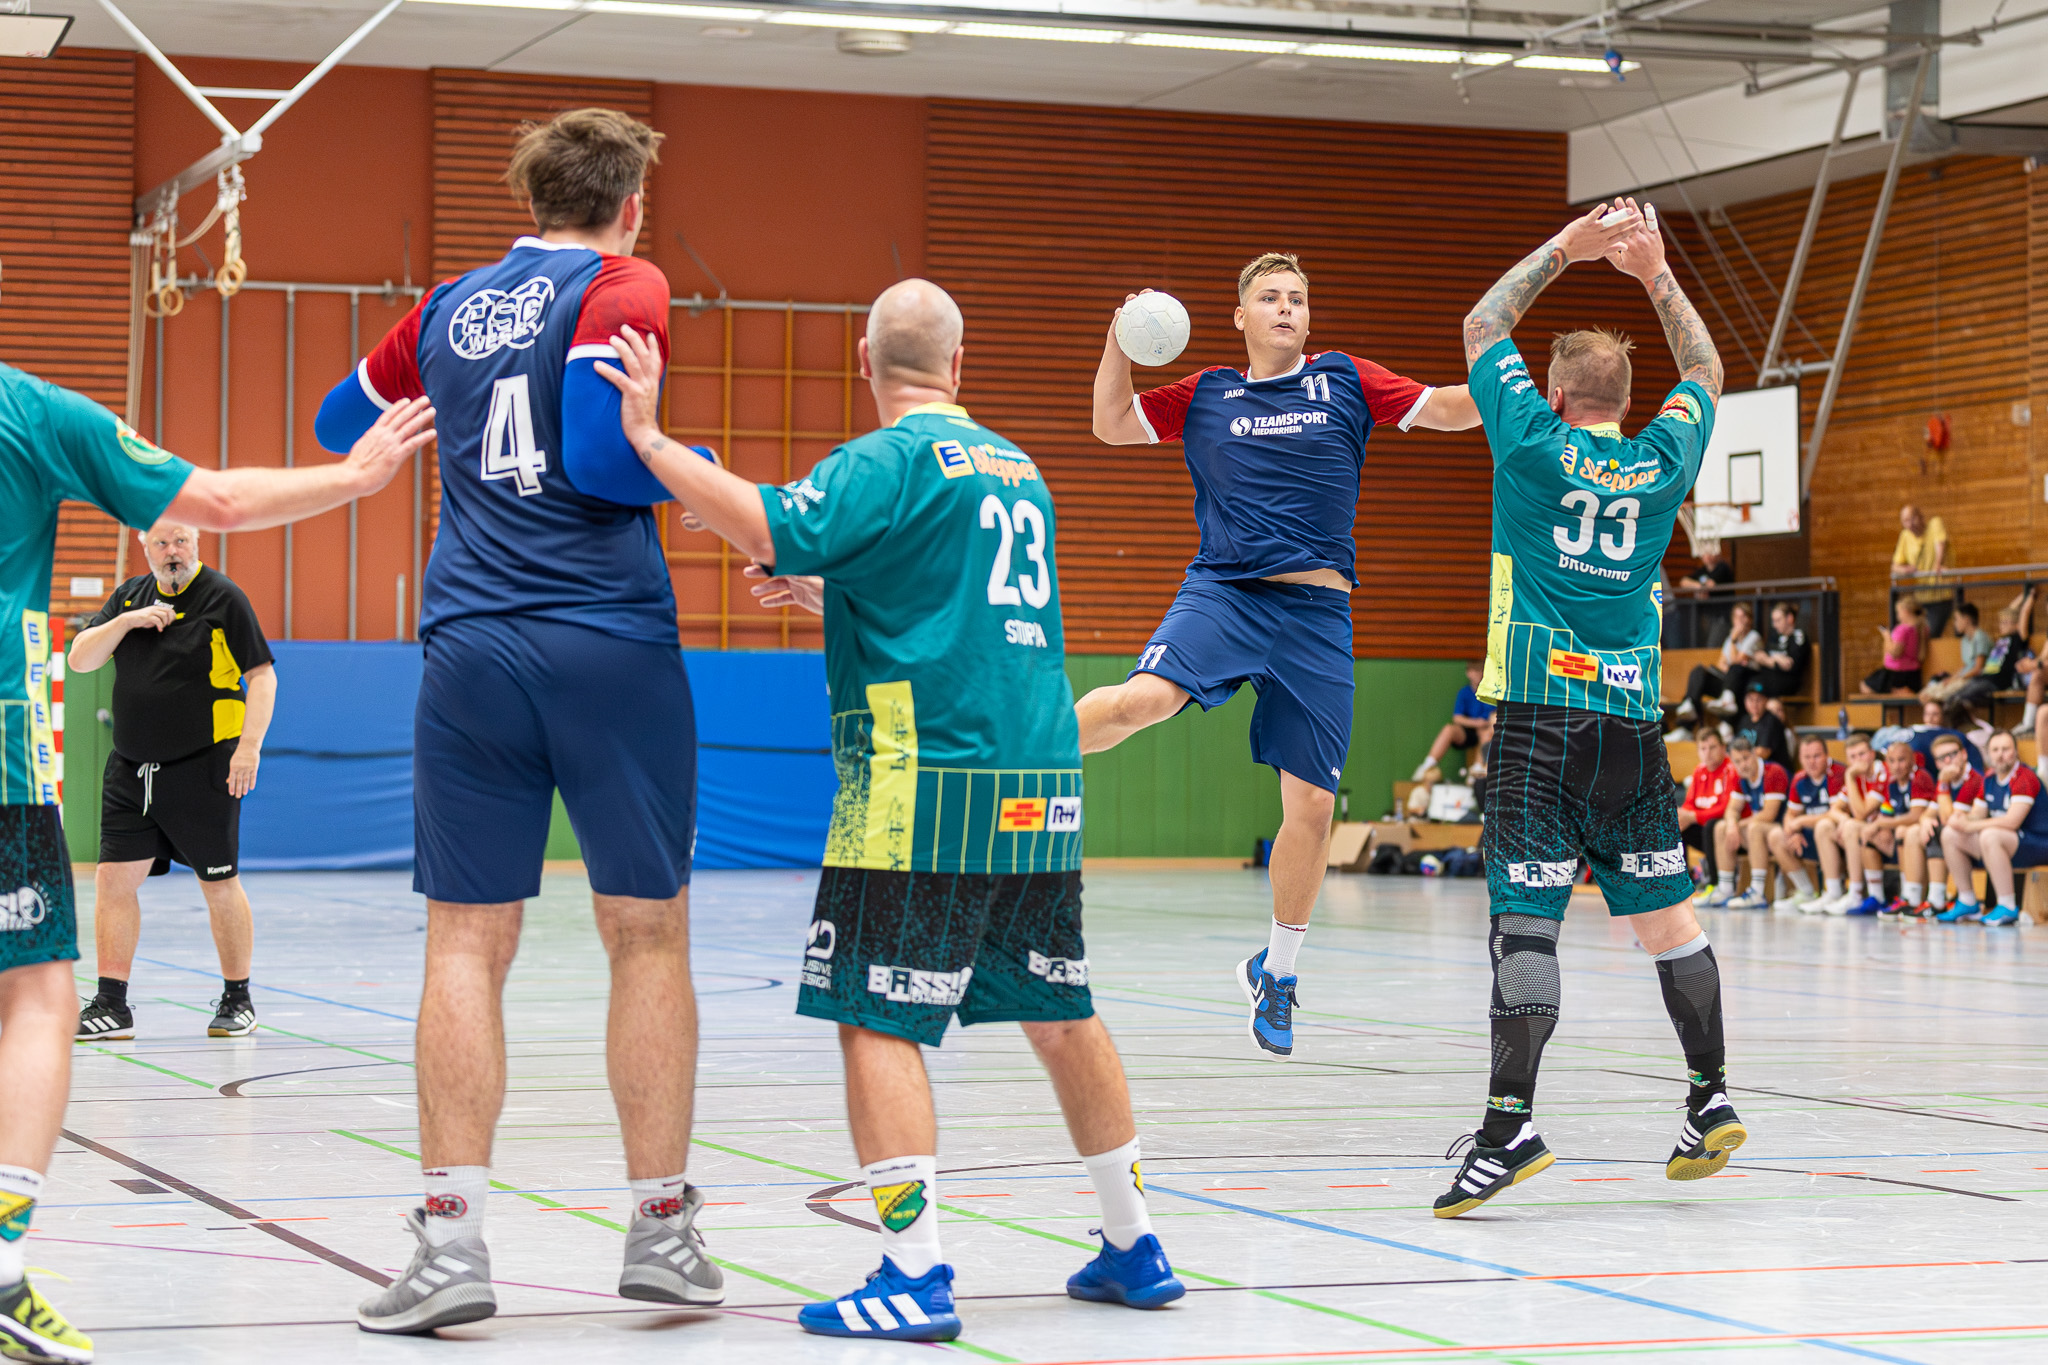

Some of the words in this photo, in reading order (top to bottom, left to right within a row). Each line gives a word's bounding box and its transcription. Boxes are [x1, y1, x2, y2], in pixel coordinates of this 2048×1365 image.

[1223, 388, 1245, 400] JAKO
[1301, 373, 1331, 401] 11
[1252, 425, 1303, 436] NIEDERRHEIN
[1253, 411, 1329, 428] TEAMSPORT
[481, 373, 547, 497] 4
[1579, 457, 1661, 493] Stepper
[1553, 489, 1640, 561] 33
[979, 493, 1051, 610] 23
[1136, 644, 1168, 670] 11
